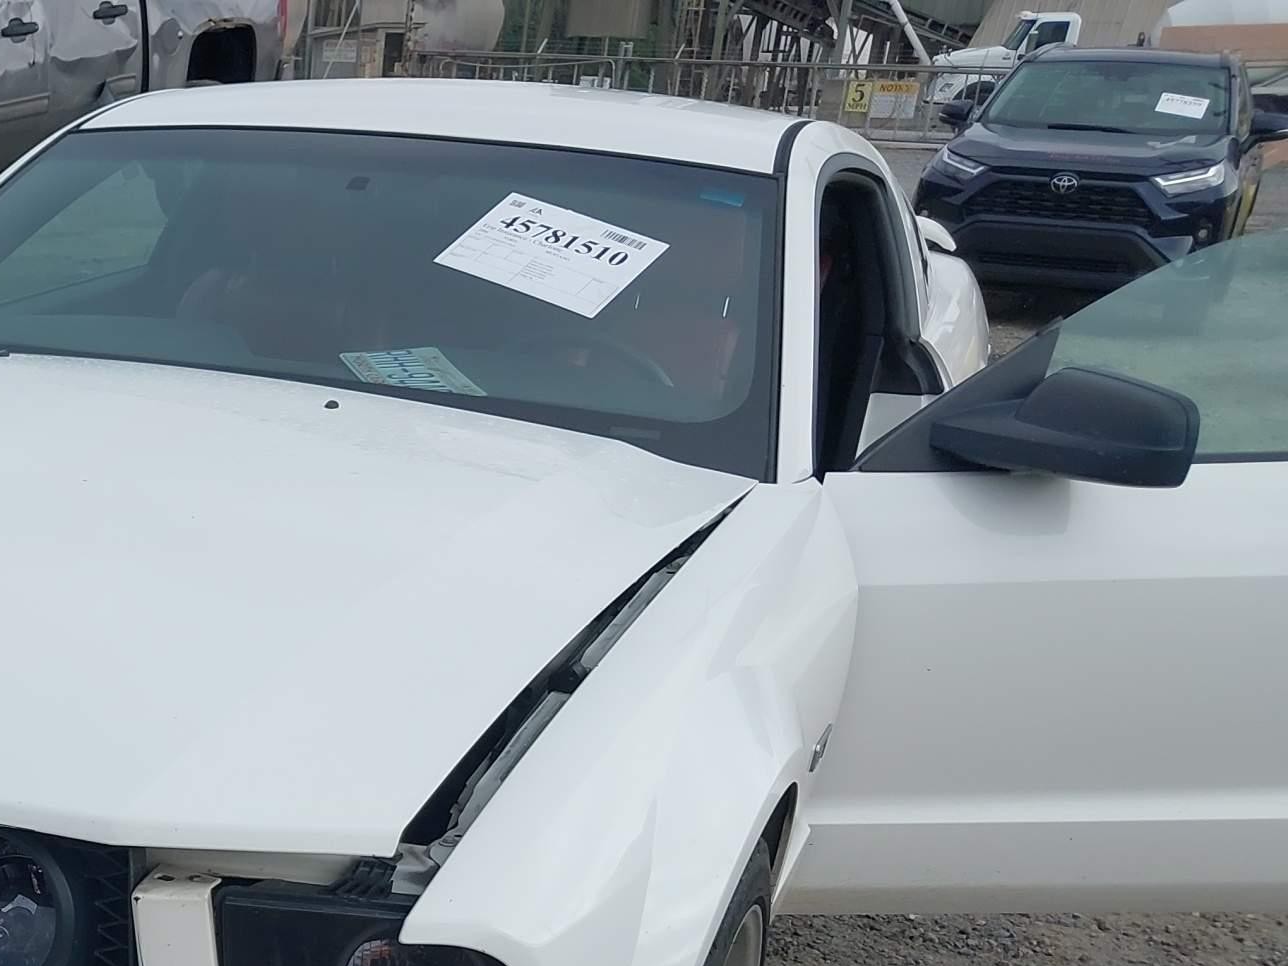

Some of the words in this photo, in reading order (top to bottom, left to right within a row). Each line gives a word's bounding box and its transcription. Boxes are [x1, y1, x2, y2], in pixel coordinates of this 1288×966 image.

[852, 83, 866, 103] 5
[845, 102, 867, 110] MPH
[500, 216, 630, 267] 45781510
